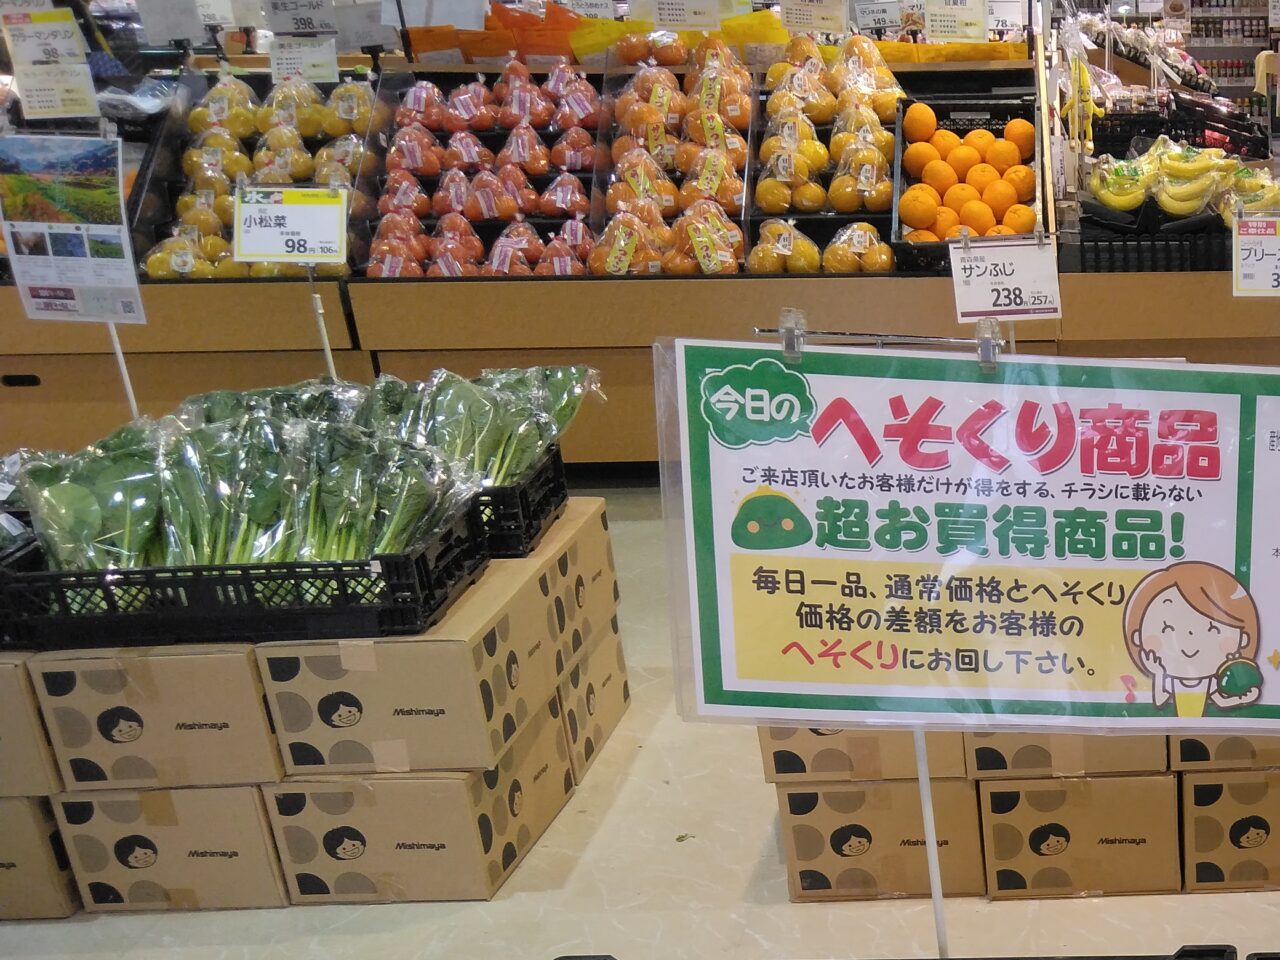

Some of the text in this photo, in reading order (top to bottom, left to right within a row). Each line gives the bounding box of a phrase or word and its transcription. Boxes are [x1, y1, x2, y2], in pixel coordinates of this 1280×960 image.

[243, 215, 288, 228] 小松菜
[961, 262, 1015, 278] サンふじ
[709, 384, 801, 423] 今日の
[810, 394, 1222, 481] へそくり商品
[741, 466, 1203, 503] ご来店頂いたお客様だけが得をする、チラシに載らない
[752, 567, 1126, 606] 毎日一品、通常価格とへそくり
[796, 602, 1084, 638] 価格の差額をお客様の
[781, 639, 1097, 676] へそくりにお回し下さい。
[392, 707, 446, 718] Mishimaya
[175, 721, 230, 731] Mishimaya
[395, 841, 446, 851] Mishimaya
[900, 838, 949, 848] Mishiya
[1097, 837, 1147, 846] Mishimaya
[187, 848, 239, 859] Mishimaya
